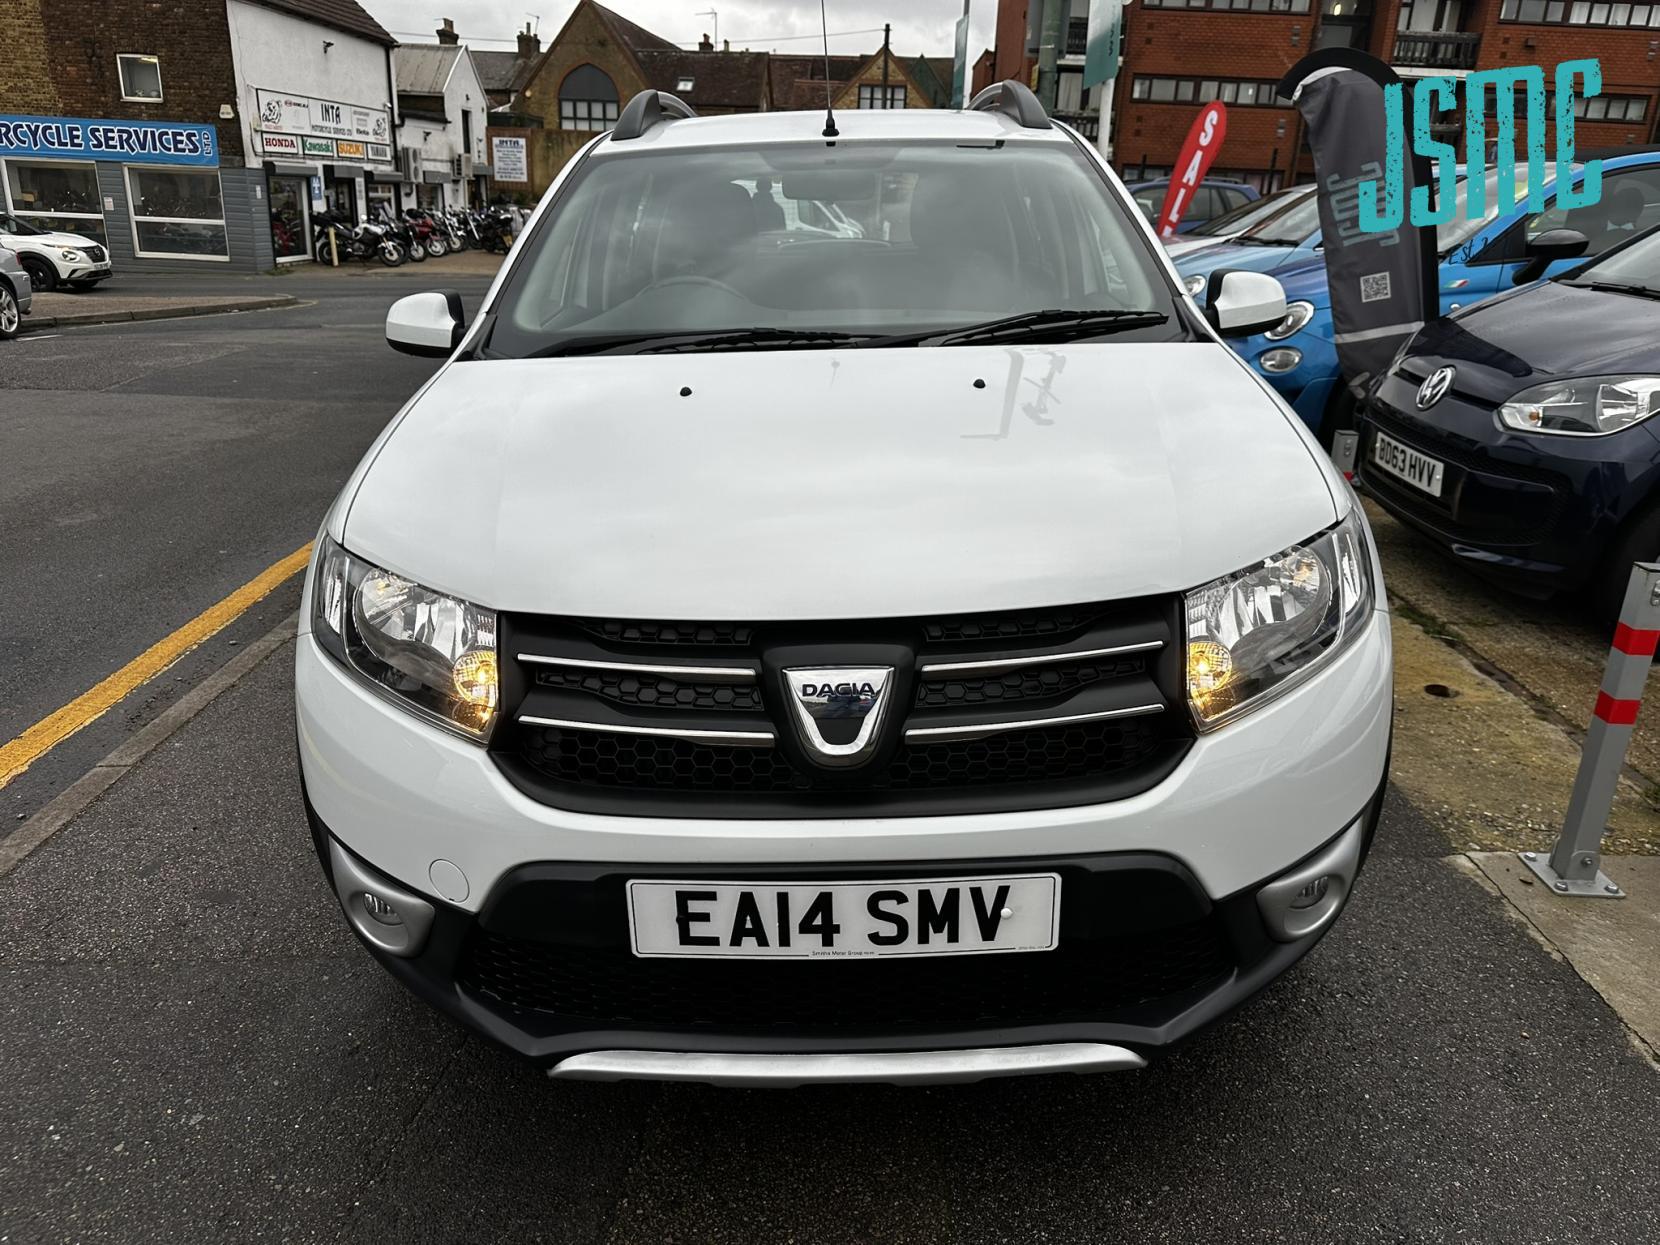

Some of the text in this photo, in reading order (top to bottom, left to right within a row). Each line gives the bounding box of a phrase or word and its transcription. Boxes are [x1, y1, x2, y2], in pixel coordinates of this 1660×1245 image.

[321, 103, 341, 124] INTA
[89, 126, 201, 155] SERVICES
[203, 131, 212, 156] LTD
[264, 137, 296, 149] HONDA
[304, 139, 333, 153] Kawasaki
[338, 142, 363, 156] SUZUKI
[1379, 437, 1407, 473] BD63
[802, 683, 875, 698] DACIA
[675, 885, 1010, 947] EA14 SMV
